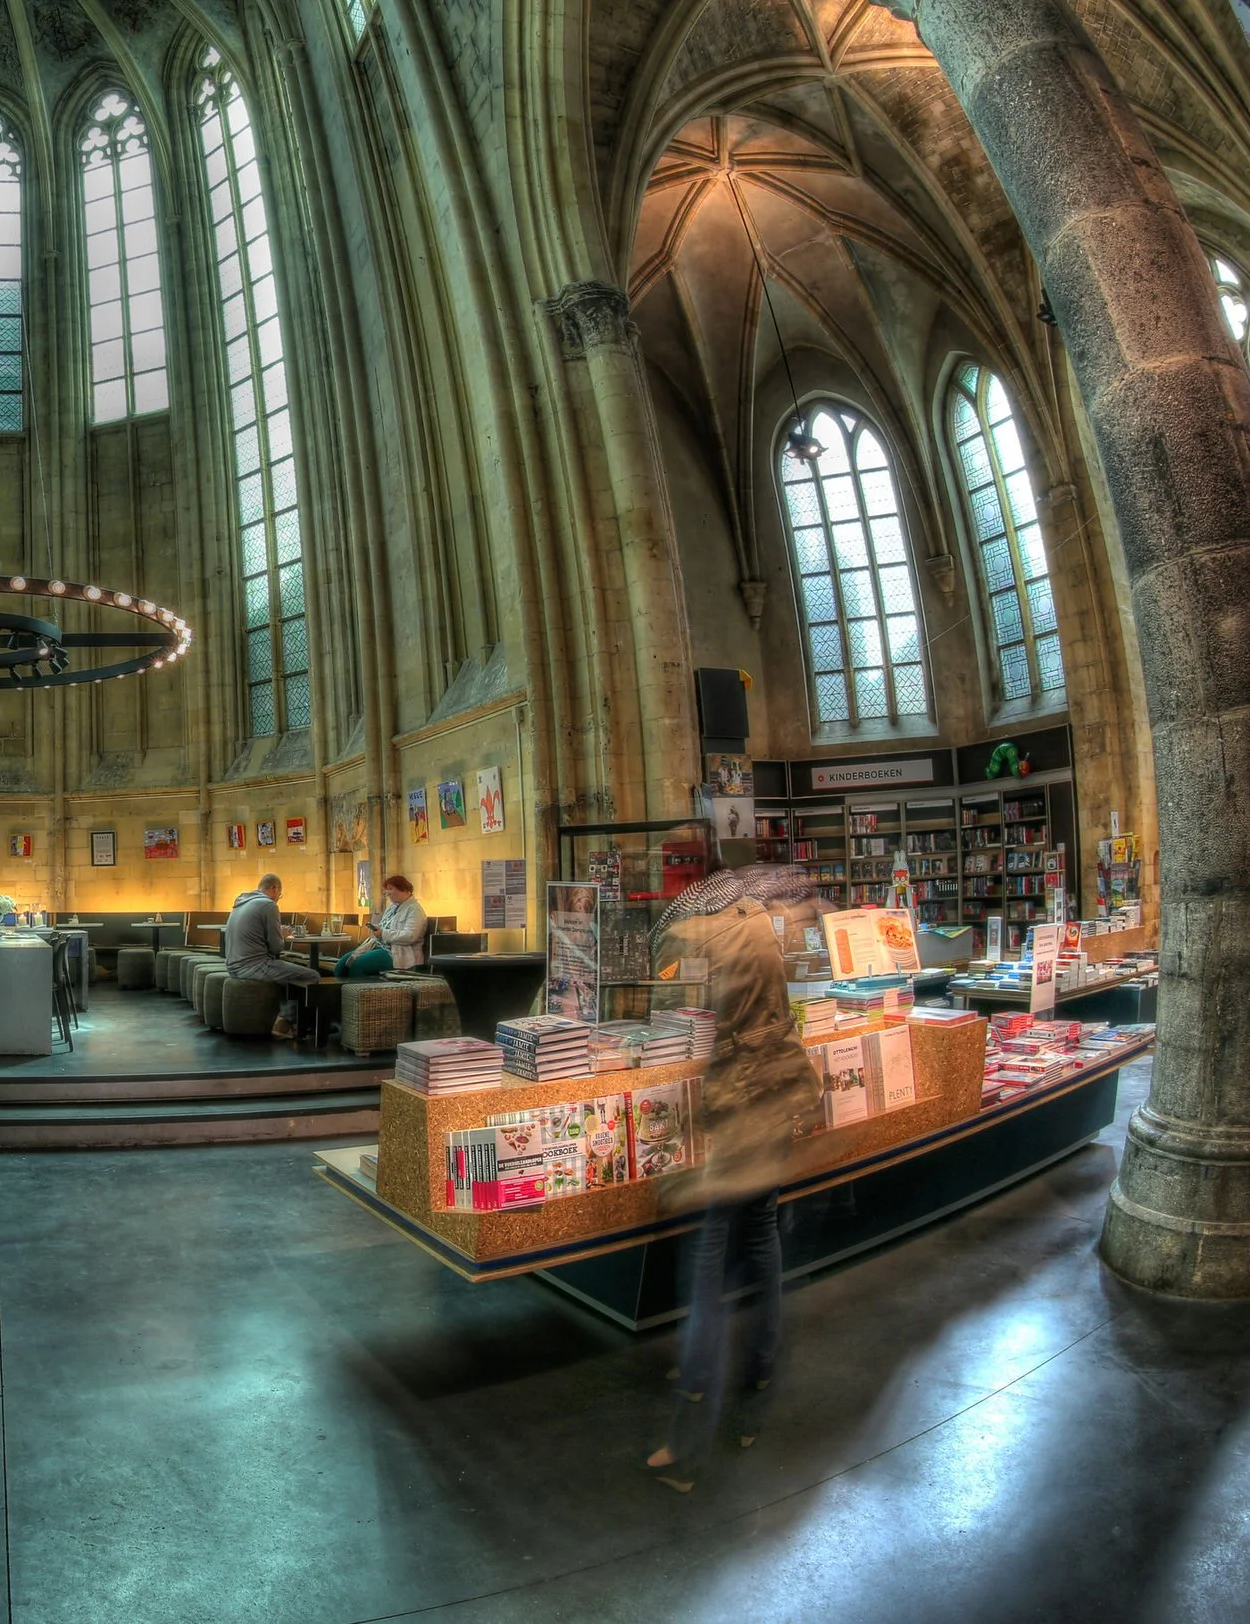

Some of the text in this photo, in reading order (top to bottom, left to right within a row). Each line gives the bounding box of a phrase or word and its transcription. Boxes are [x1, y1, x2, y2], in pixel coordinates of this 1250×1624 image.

[829, 768, 903, 782] KINDERBOEKEN
[516, 1030, 534, 1041] JAMIE
[512, 1039, 530, 1051] JAMIE
[832, 1046, 858, 1056] OTTOLENGHI
[514, 1049, 530, 1061] JAMIE
[515, 1059, 532, 1070] JAMIE
[516, 1067, 533, 1080] JAMIE
[888, 1086, 913, 1100] PLENTY
